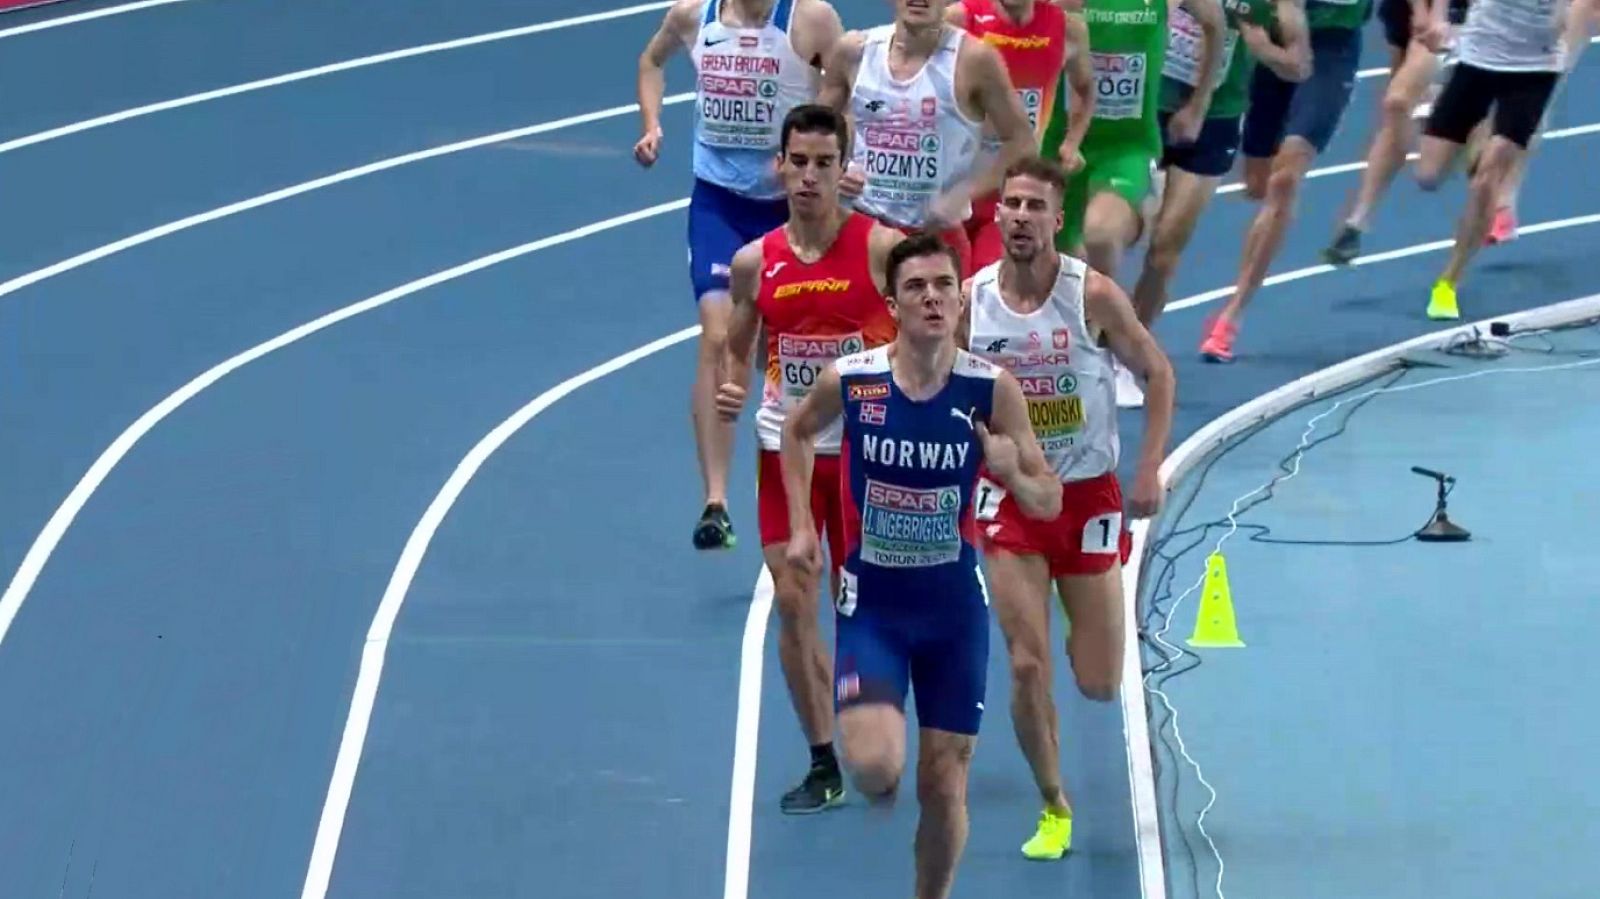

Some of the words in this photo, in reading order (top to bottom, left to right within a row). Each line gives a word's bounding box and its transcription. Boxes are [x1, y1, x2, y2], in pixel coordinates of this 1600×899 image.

[735, 56, 780, 74] BRITAIN
[704, 79, 756, 95] SPAR
[1090, 75, 1139, 96] ÖGI
[703, 97, 775, 122] GOURLEY
[866, 128, 919, 151] SPAR
[866, 150, 937, 178] ROZMYS
[773, 278, 850, 299] ESPAÑA
[780, 337, 838, 358] SPAR
[1019, 379, 1053, 394] AR
[863, 434, 970, 470] NORWAY
[870, 486, 937, 511] SPAR
[865, 508, 874, 532] J.
[877, 511, 959, 541] INGEBRIGTSEN
[1099, 518, 1110, 548] 1
